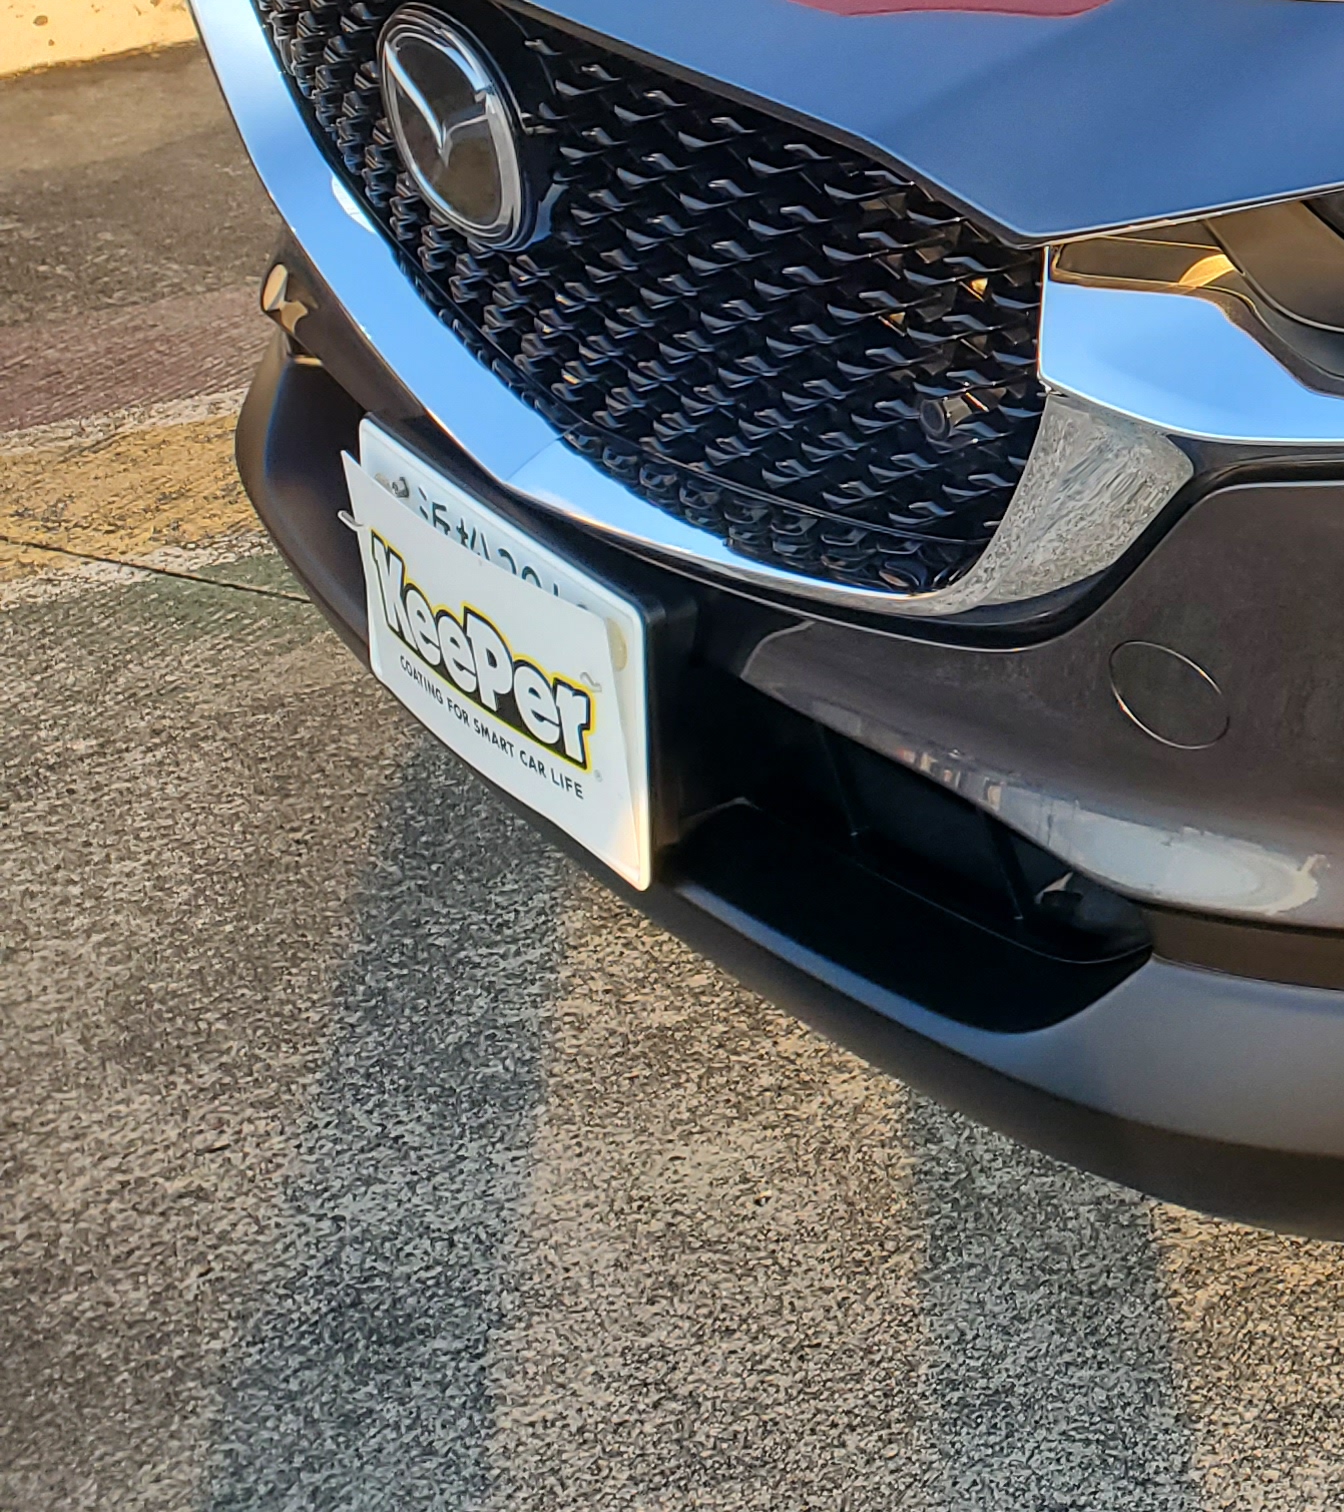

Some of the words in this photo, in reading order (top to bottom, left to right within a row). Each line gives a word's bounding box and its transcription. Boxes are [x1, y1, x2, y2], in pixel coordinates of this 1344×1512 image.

[370, 528, 592, 771] KeePer
[399, 653, 445, 707] COATING
[446, 696, 471, 730] FOR
[472, 716, 516, 760] SMART
[518, 748, 547, 778] CAR
[551, 767, 585, 801] LIFE
